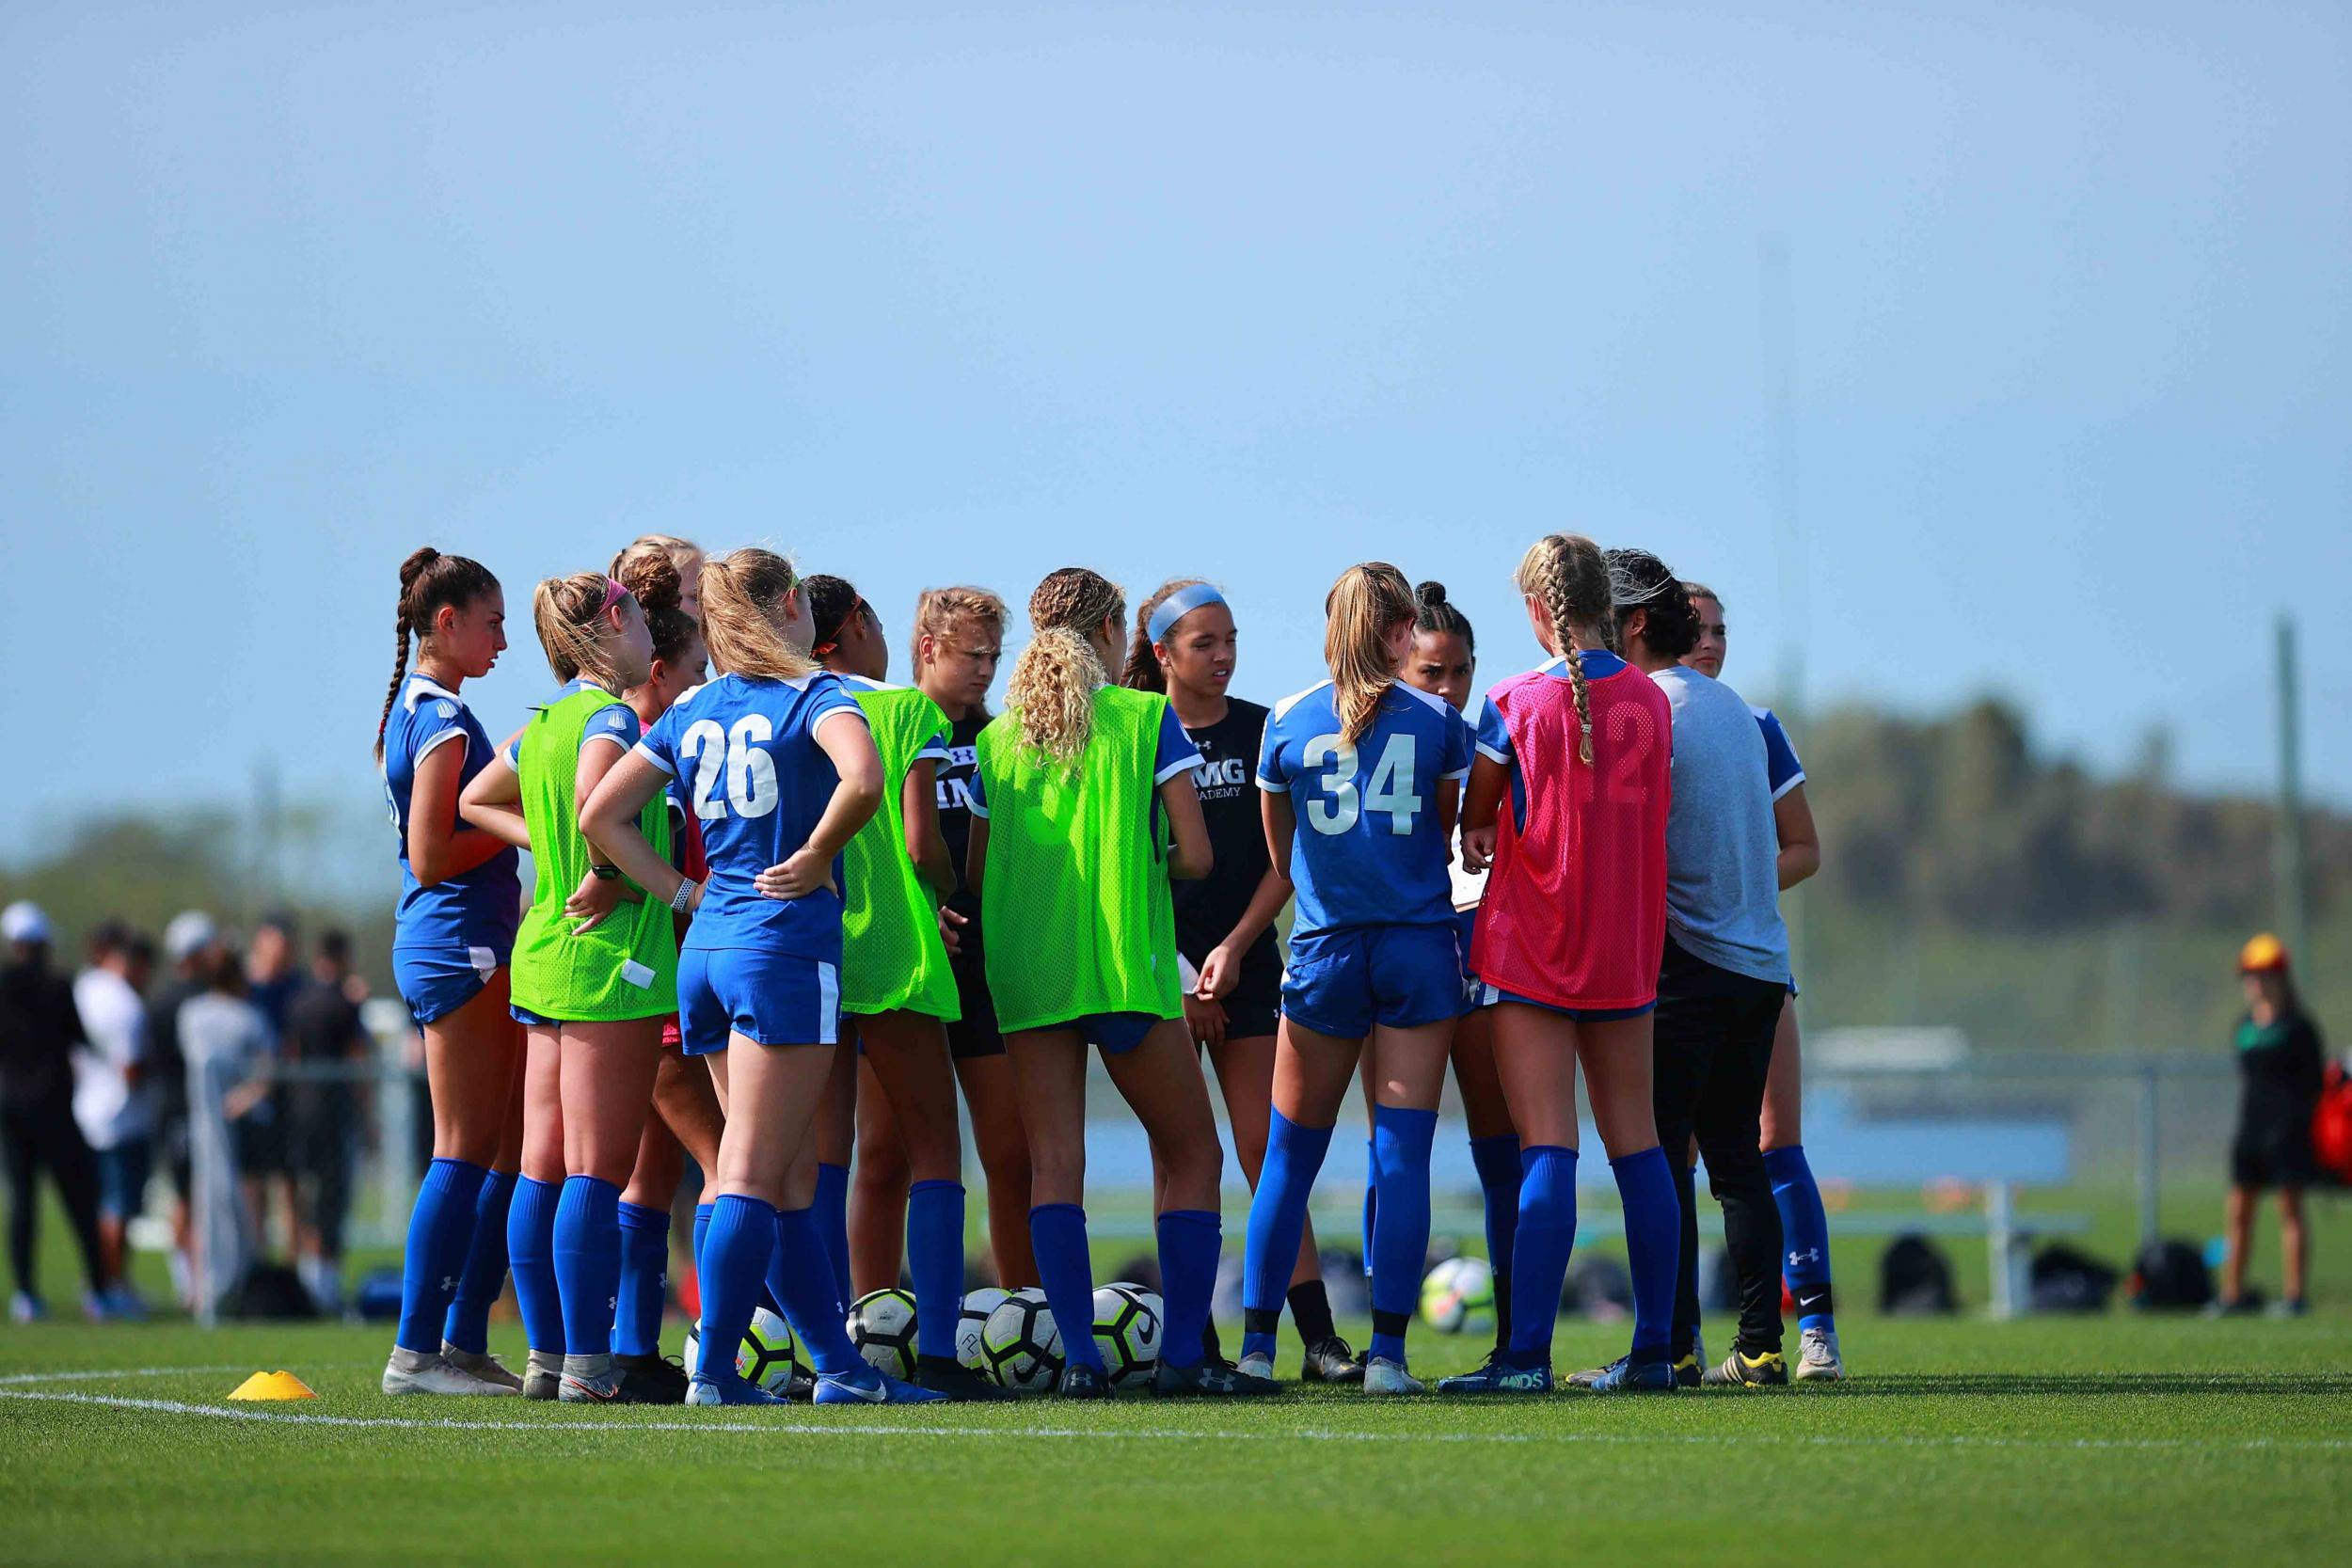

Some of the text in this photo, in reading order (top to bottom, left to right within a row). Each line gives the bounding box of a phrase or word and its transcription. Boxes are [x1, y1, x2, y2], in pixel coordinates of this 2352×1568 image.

[681, 713, 779, 819] 26
[1192, 758, 1246, 788] MG
[1199, 786, 1241, 801] ADEMY
[1303, 733, 1422, 835] 34
